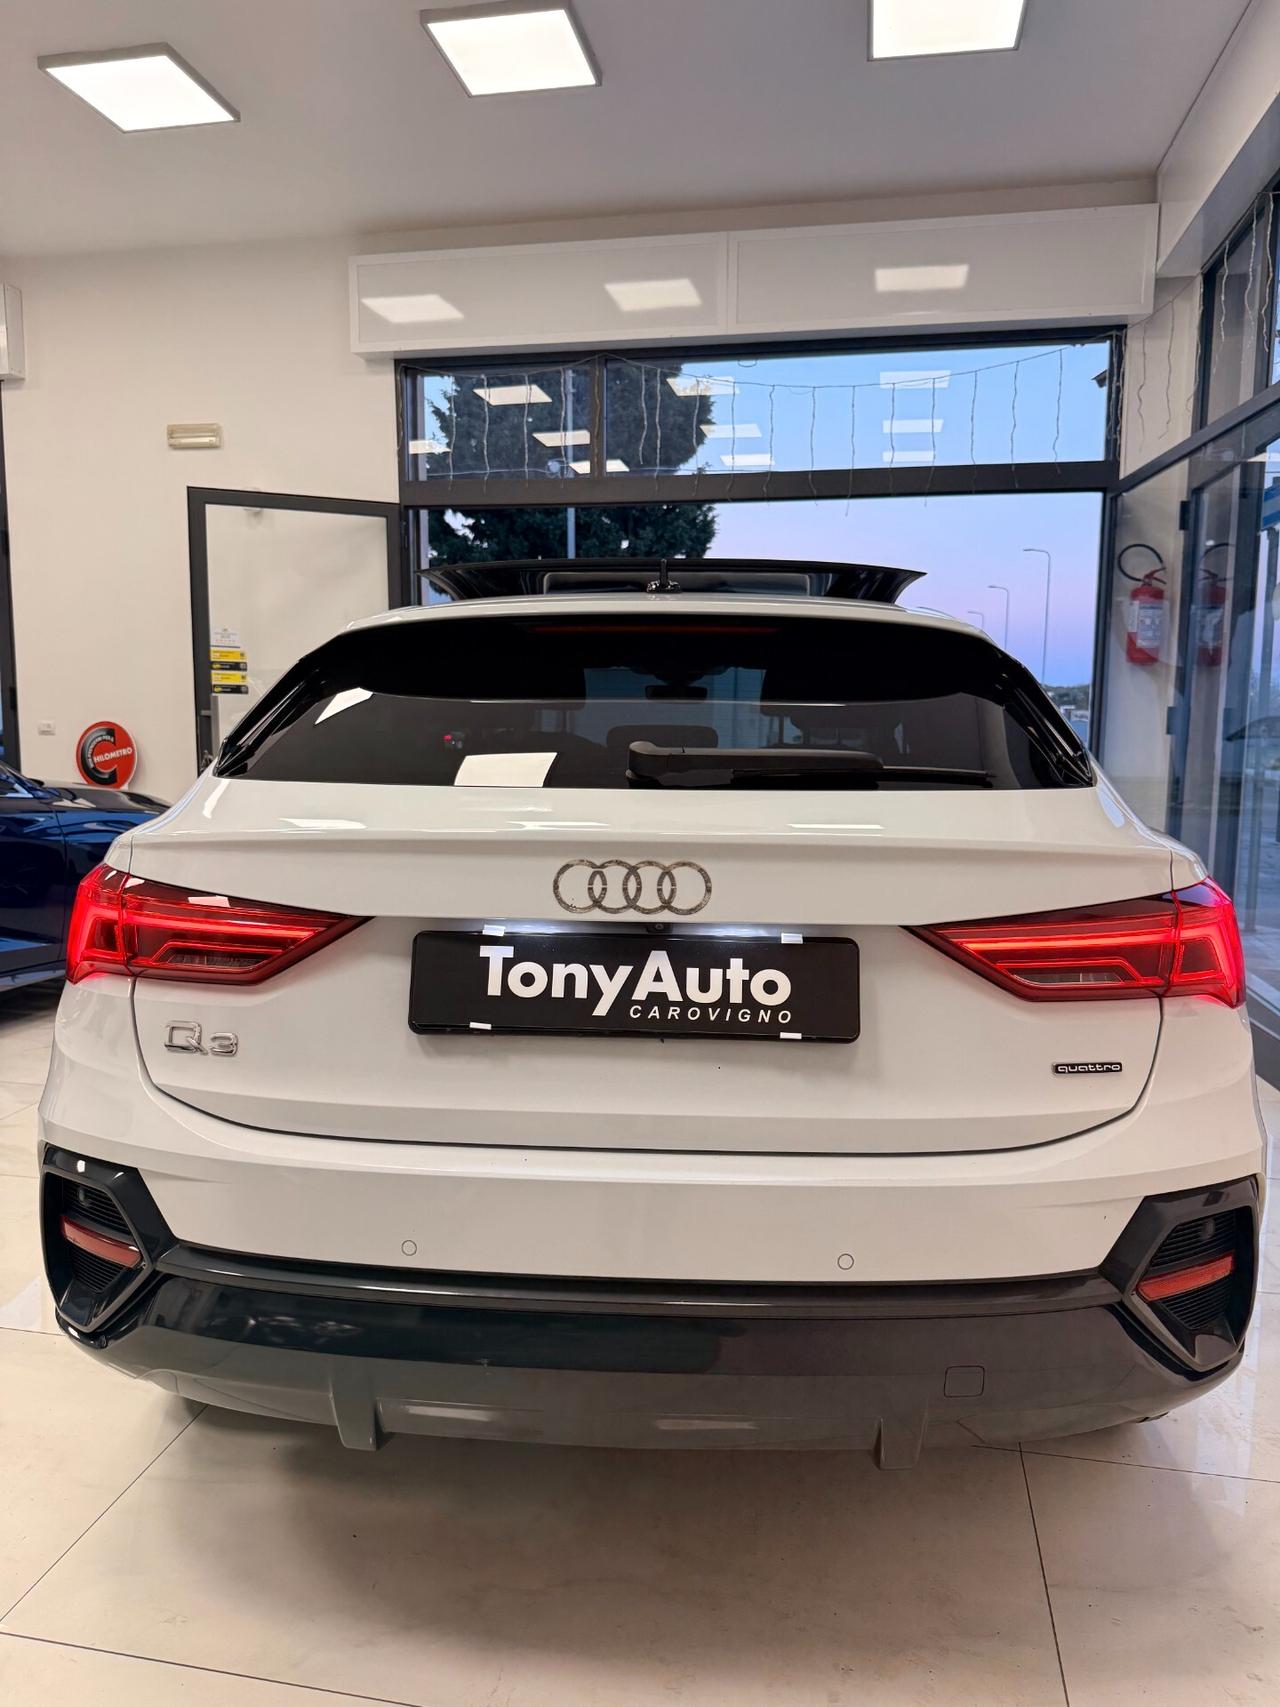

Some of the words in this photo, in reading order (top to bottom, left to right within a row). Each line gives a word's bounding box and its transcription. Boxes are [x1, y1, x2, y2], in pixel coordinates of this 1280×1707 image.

[479, 945, 792, 1016] TonyAuto
[629, 1005, 792, 1024] CAROVIGNO
[164, 1020, 239, 1058] Q3
[1057, 1063, 1121, 1073] quattro
